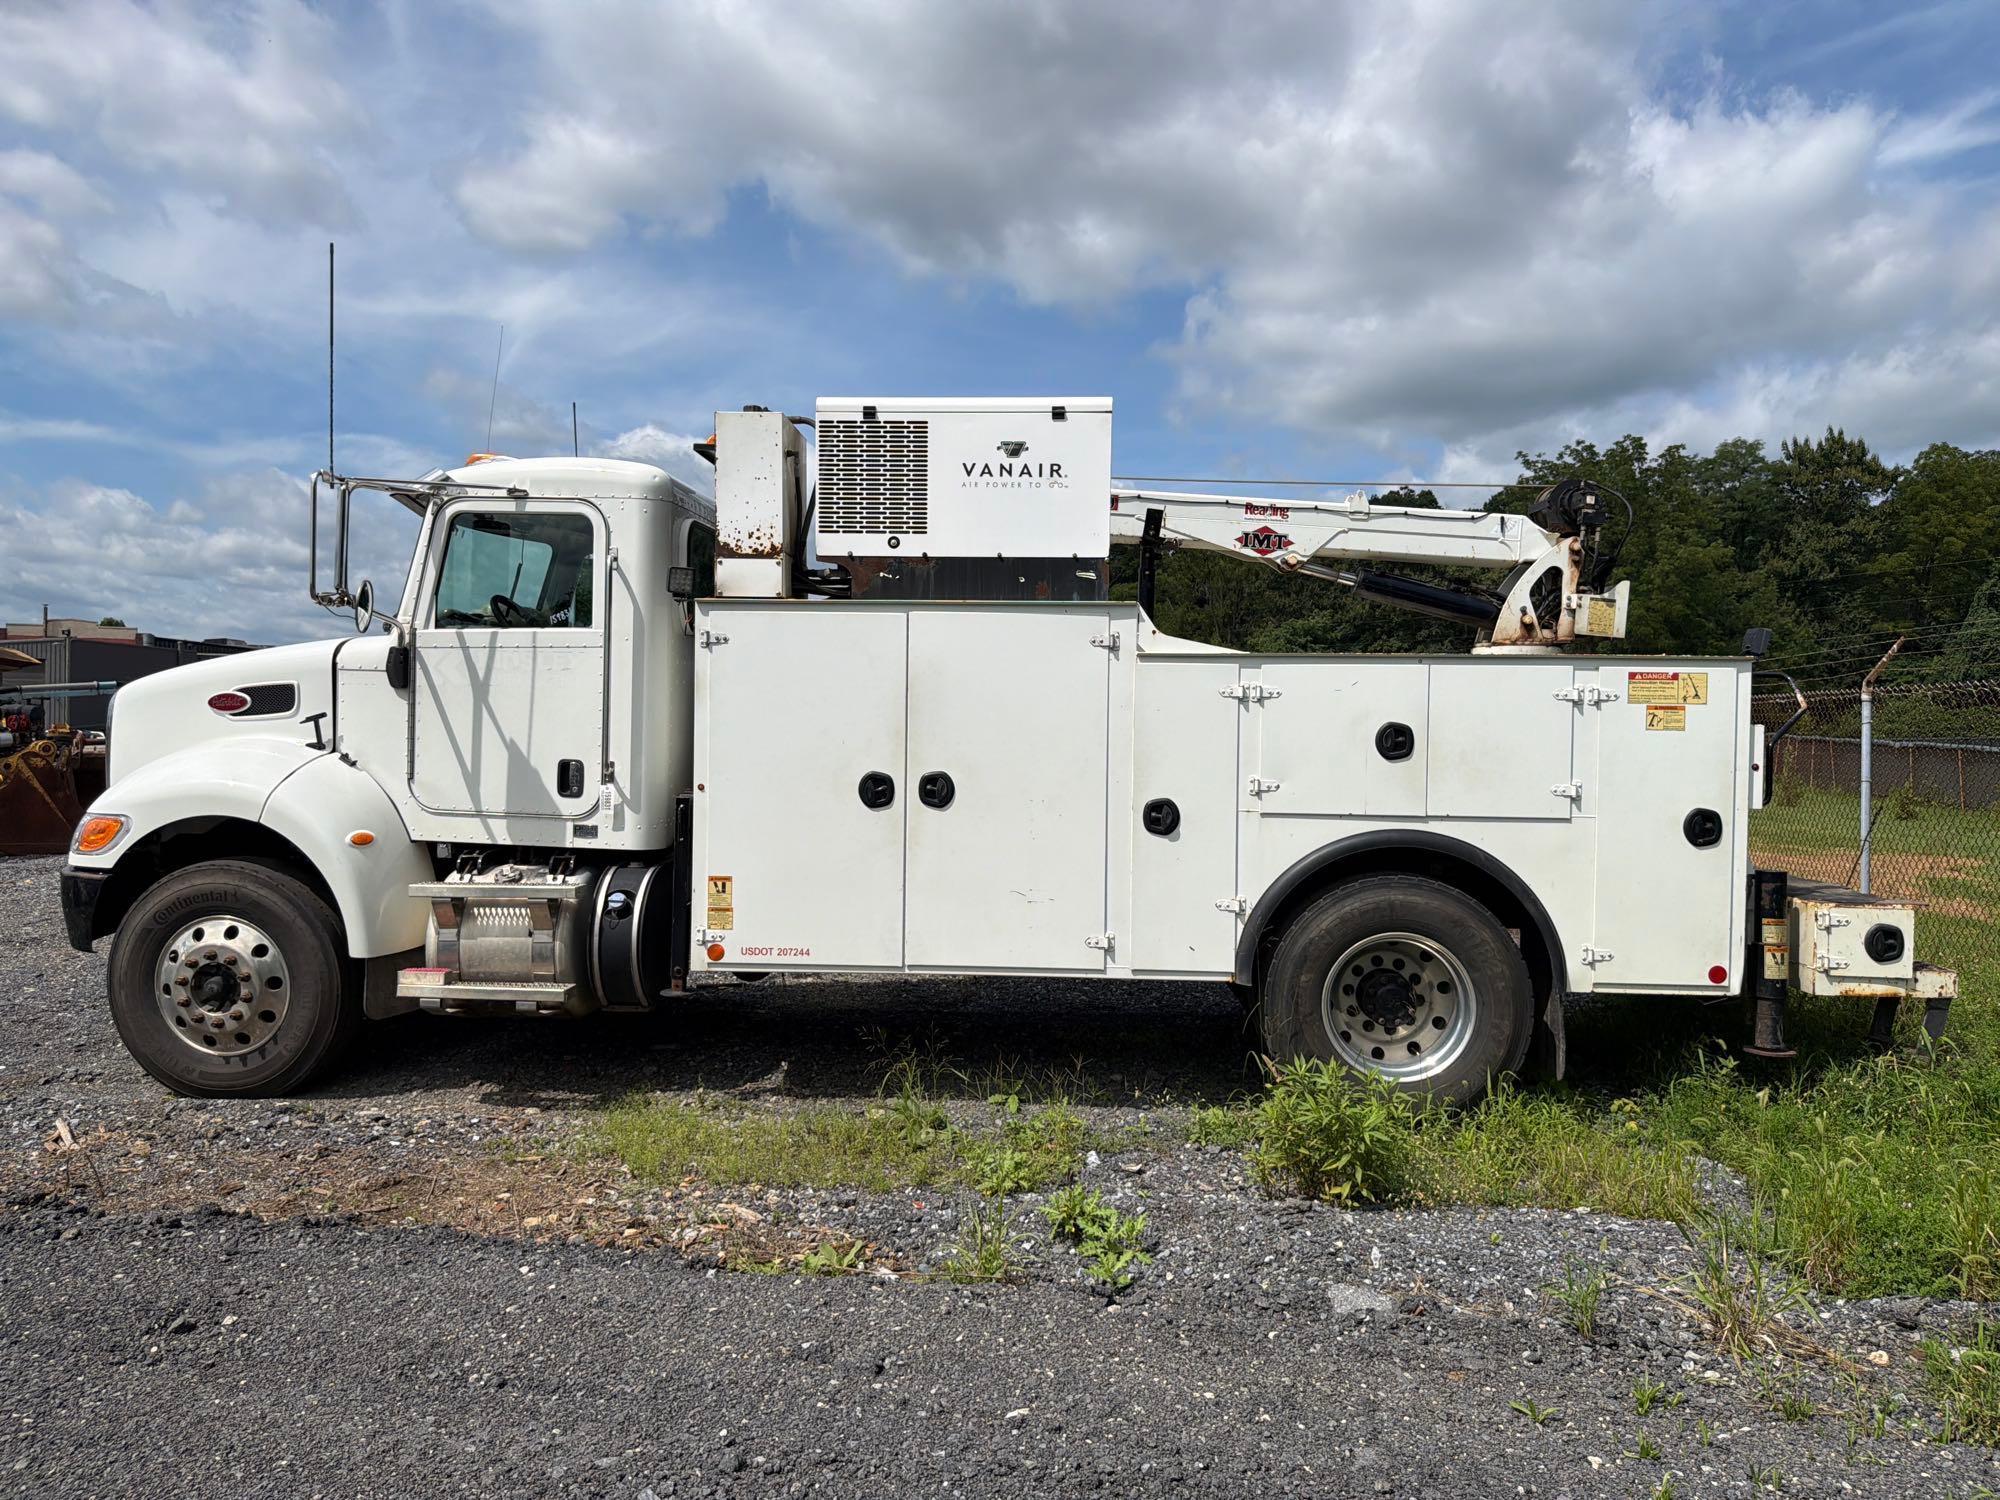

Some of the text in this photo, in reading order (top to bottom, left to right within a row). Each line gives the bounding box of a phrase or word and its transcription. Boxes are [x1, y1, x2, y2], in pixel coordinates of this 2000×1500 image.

[985, 481, 1022, 489] POWER
[1029, 481, 1042, 489] TO
[1241, 531, 1289, 550] IMT
[740, 946, 811, 957] USDOT 207244
